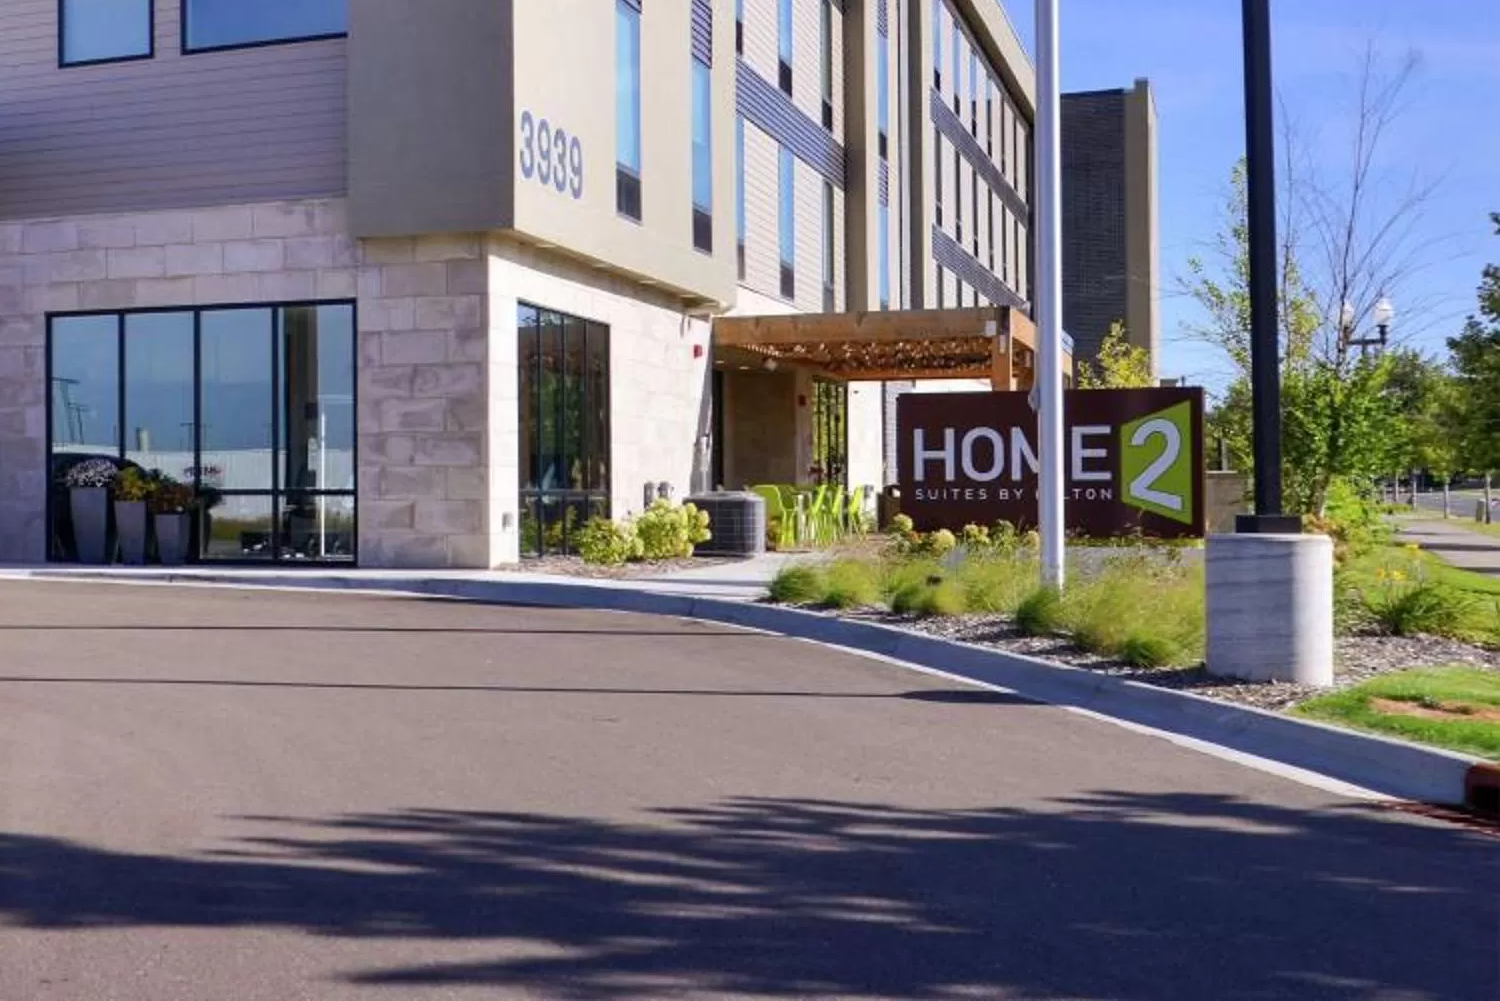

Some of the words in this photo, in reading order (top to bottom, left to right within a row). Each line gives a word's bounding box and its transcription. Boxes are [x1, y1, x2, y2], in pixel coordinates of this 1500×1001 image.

[519, 110, 583, 200] 3939
[915, 488, 988, 500] SUITES
[999, 488, 1024, 500] BY
[1035, 488, 1113, 500] TON
[1129, 418, 1182, 511] 2
